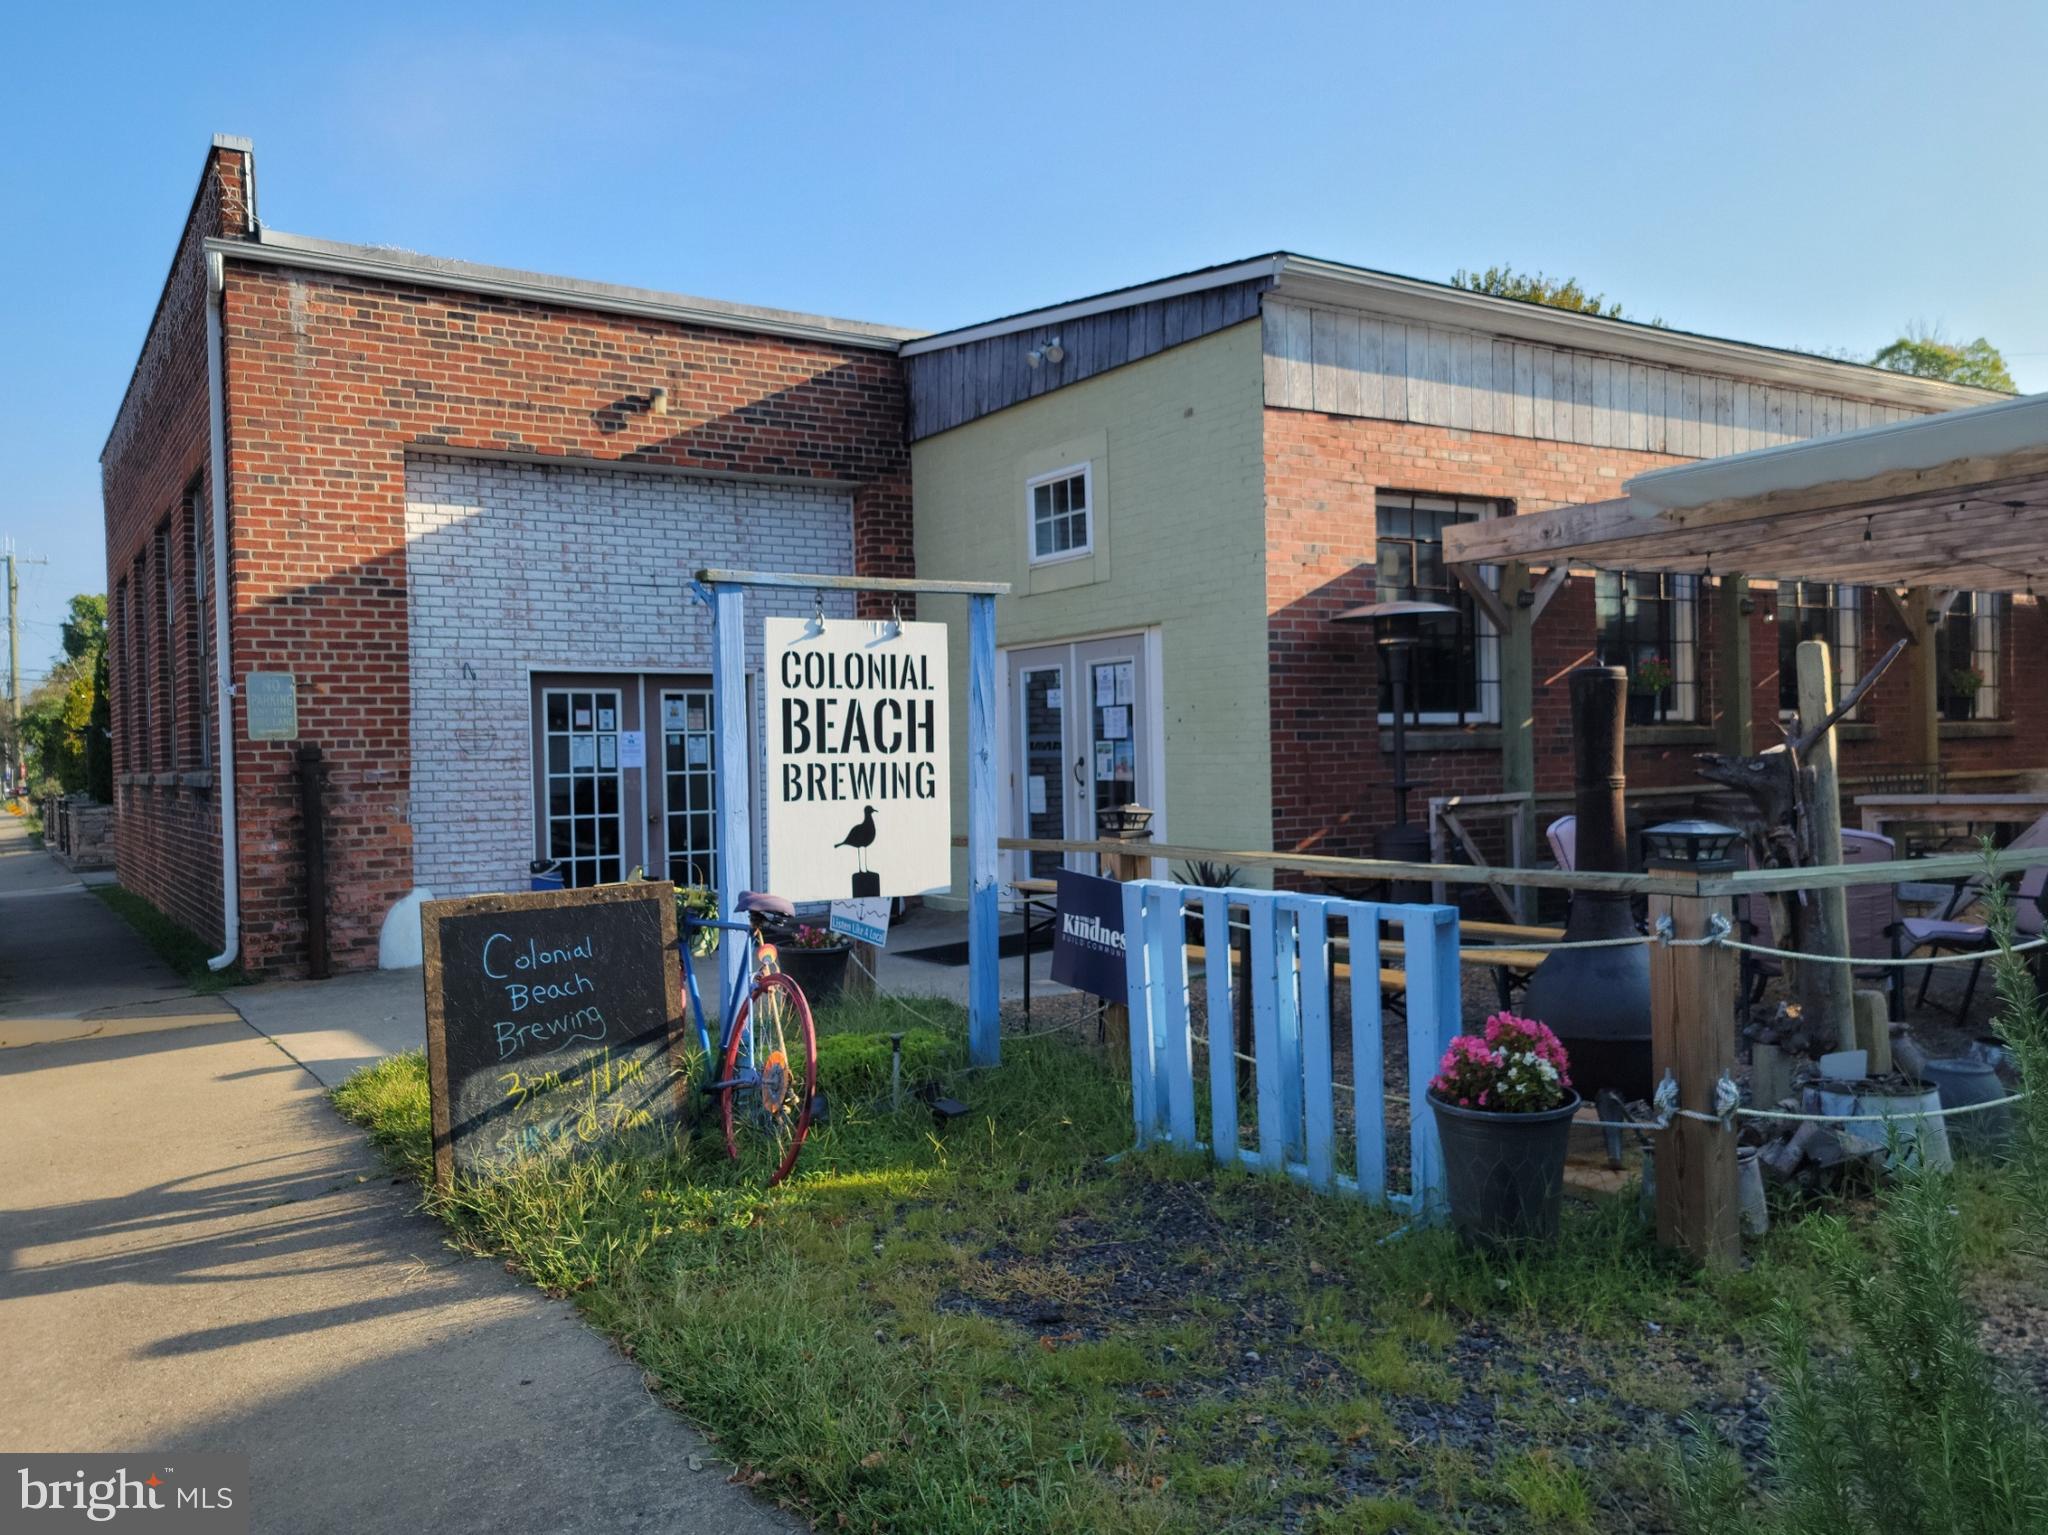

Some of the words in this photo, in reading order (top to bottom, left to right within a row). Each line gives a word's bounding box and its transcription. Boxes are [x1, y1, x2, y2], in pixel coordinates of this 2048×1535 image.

[262, 679, 281, 692] NO
[781, 651, 934, 690] COLONIAL
[251, 693, 293, 706] PARKING
[781, 698, 935, 754] BEACH
[782, 761, 935, 802] BREWING
[1063, 912, 1127, 950] Kindnes
[483, 933, 593, 979] Colonial
[505, 973, 595, 1012] Beach
[493, 1006, 607, 1061] Brewing
